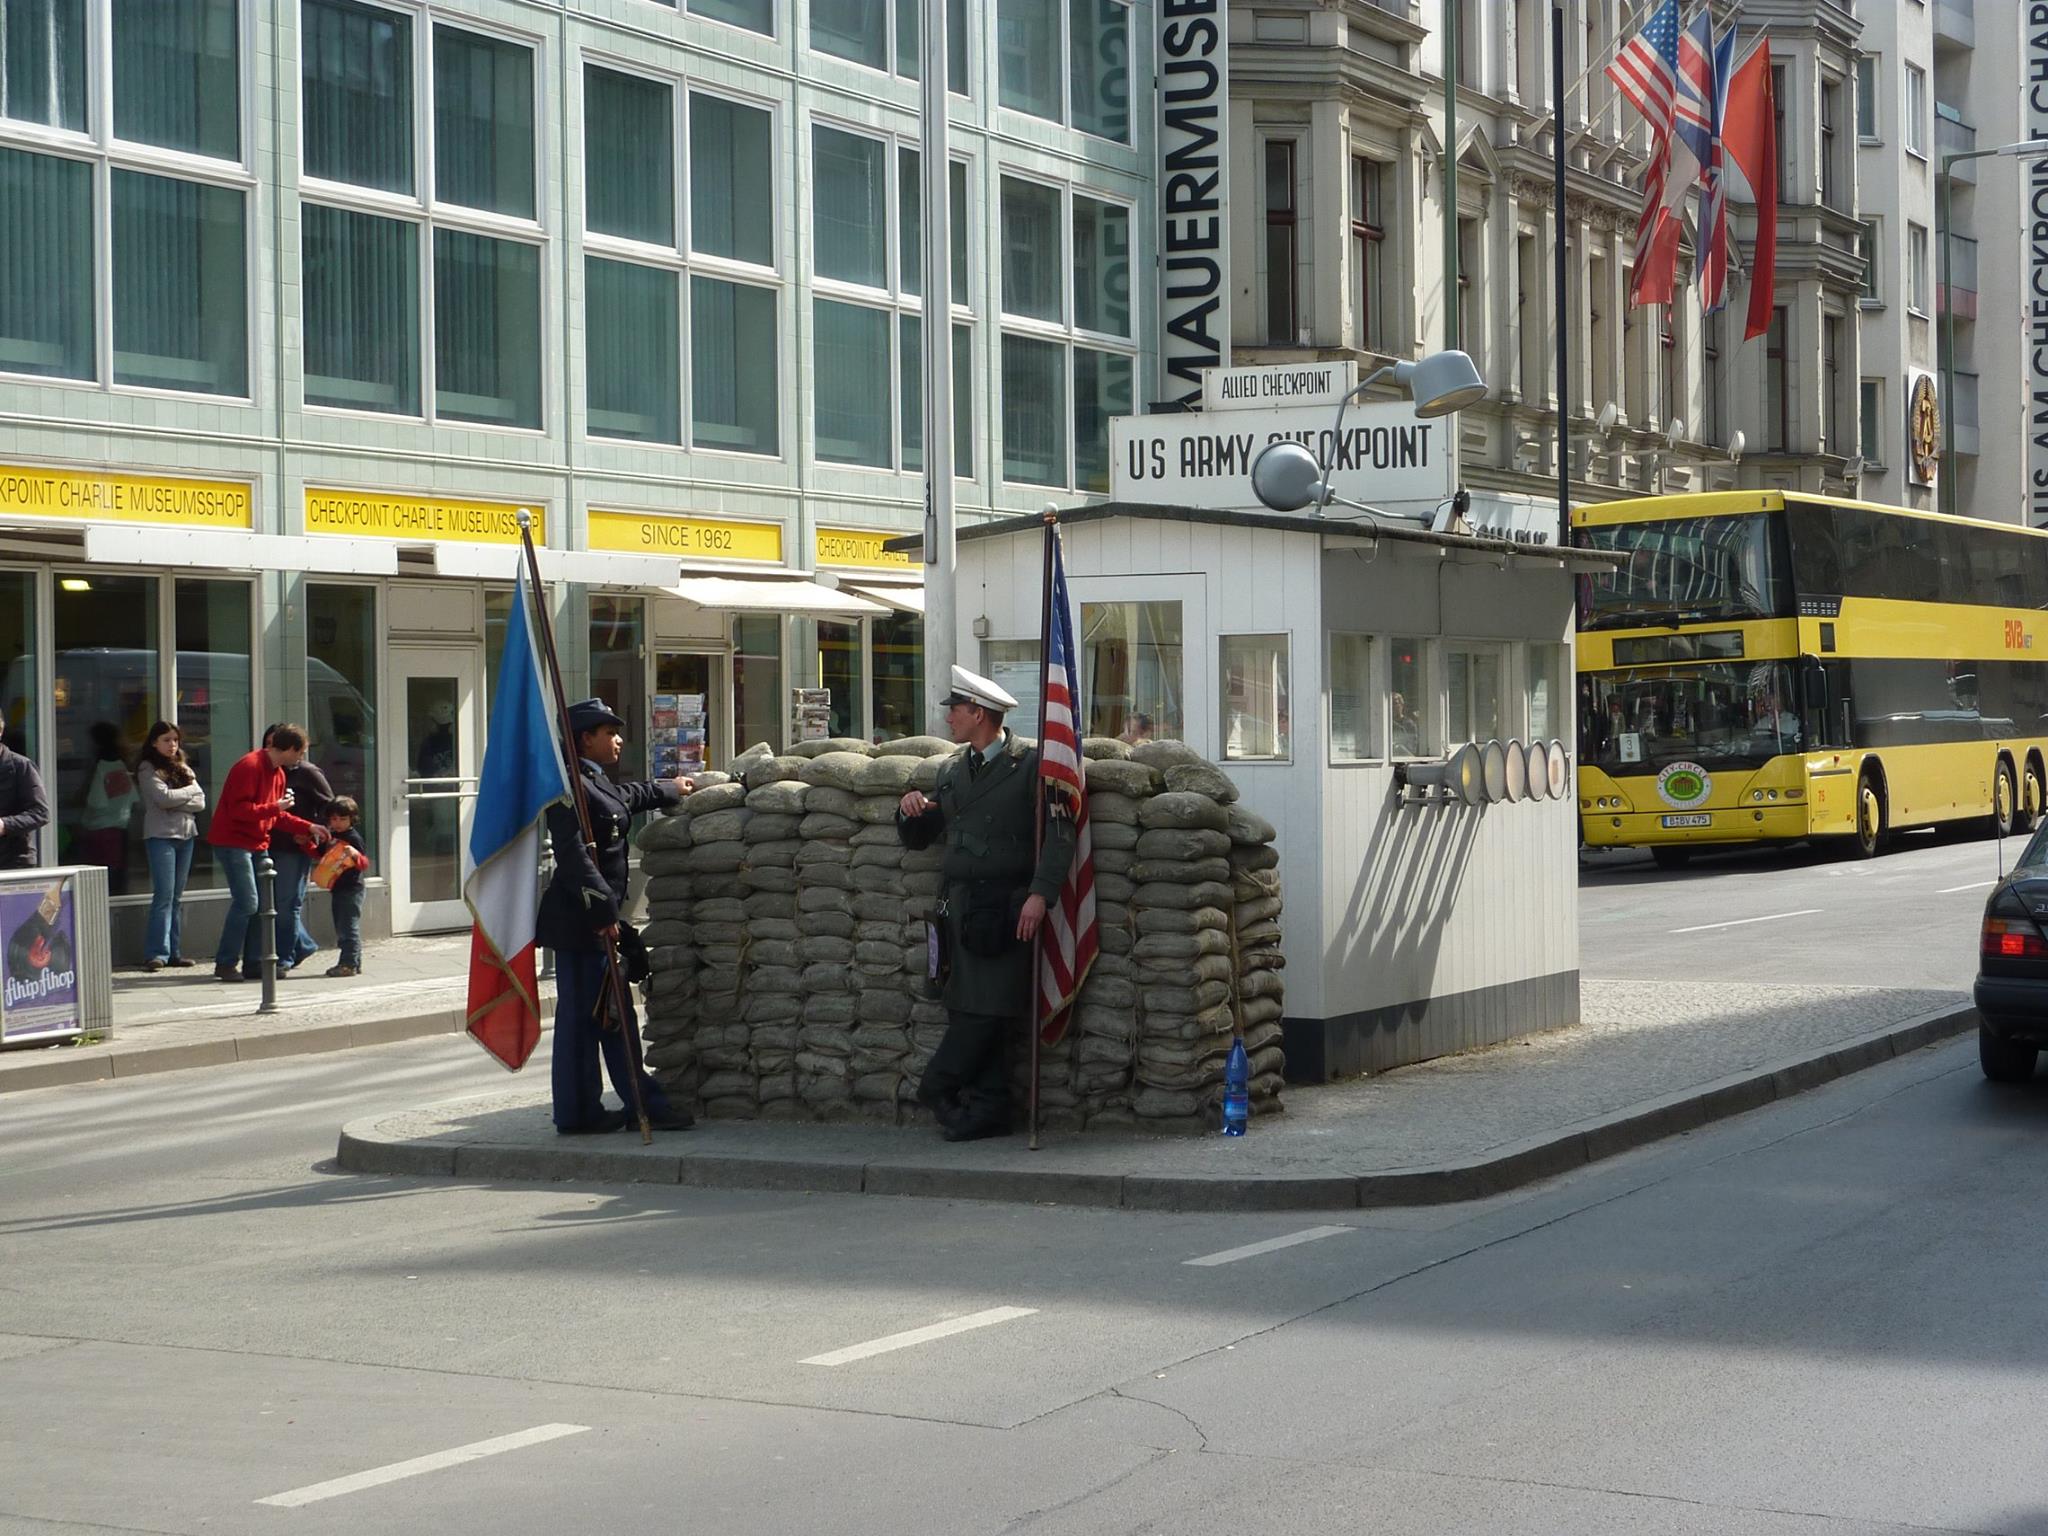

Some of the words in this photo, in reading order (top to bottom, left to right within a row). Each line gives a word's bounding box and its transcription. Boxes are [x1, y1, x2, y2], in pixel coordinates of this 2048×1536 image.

[1221, 374, 1258, 399] ALLIED
[1262, 370, 1332, 396] CHECKPOINT
[1129, 438, 1166, 480] US
[1180, 433, 1254, 478] ARMY
[1267, 424, 1432, 472] CKPOINT
[59, 481, 124, 510] CHARLIE
[130, 486, 244, 517] MUSEUMSSHOP
[310, 499, 390, 527] CHECKPOINT
[393, 505, 443, 530] CHARLIE
[449, 509, 539, 536] MUSEUMSSP
[641, 523, 689, 546] SINCE
[695, 528, 732, 549] 1962
[818, 538, 871, 560] CHECKPOINT
[1691, 815, 1707, 824] 475
